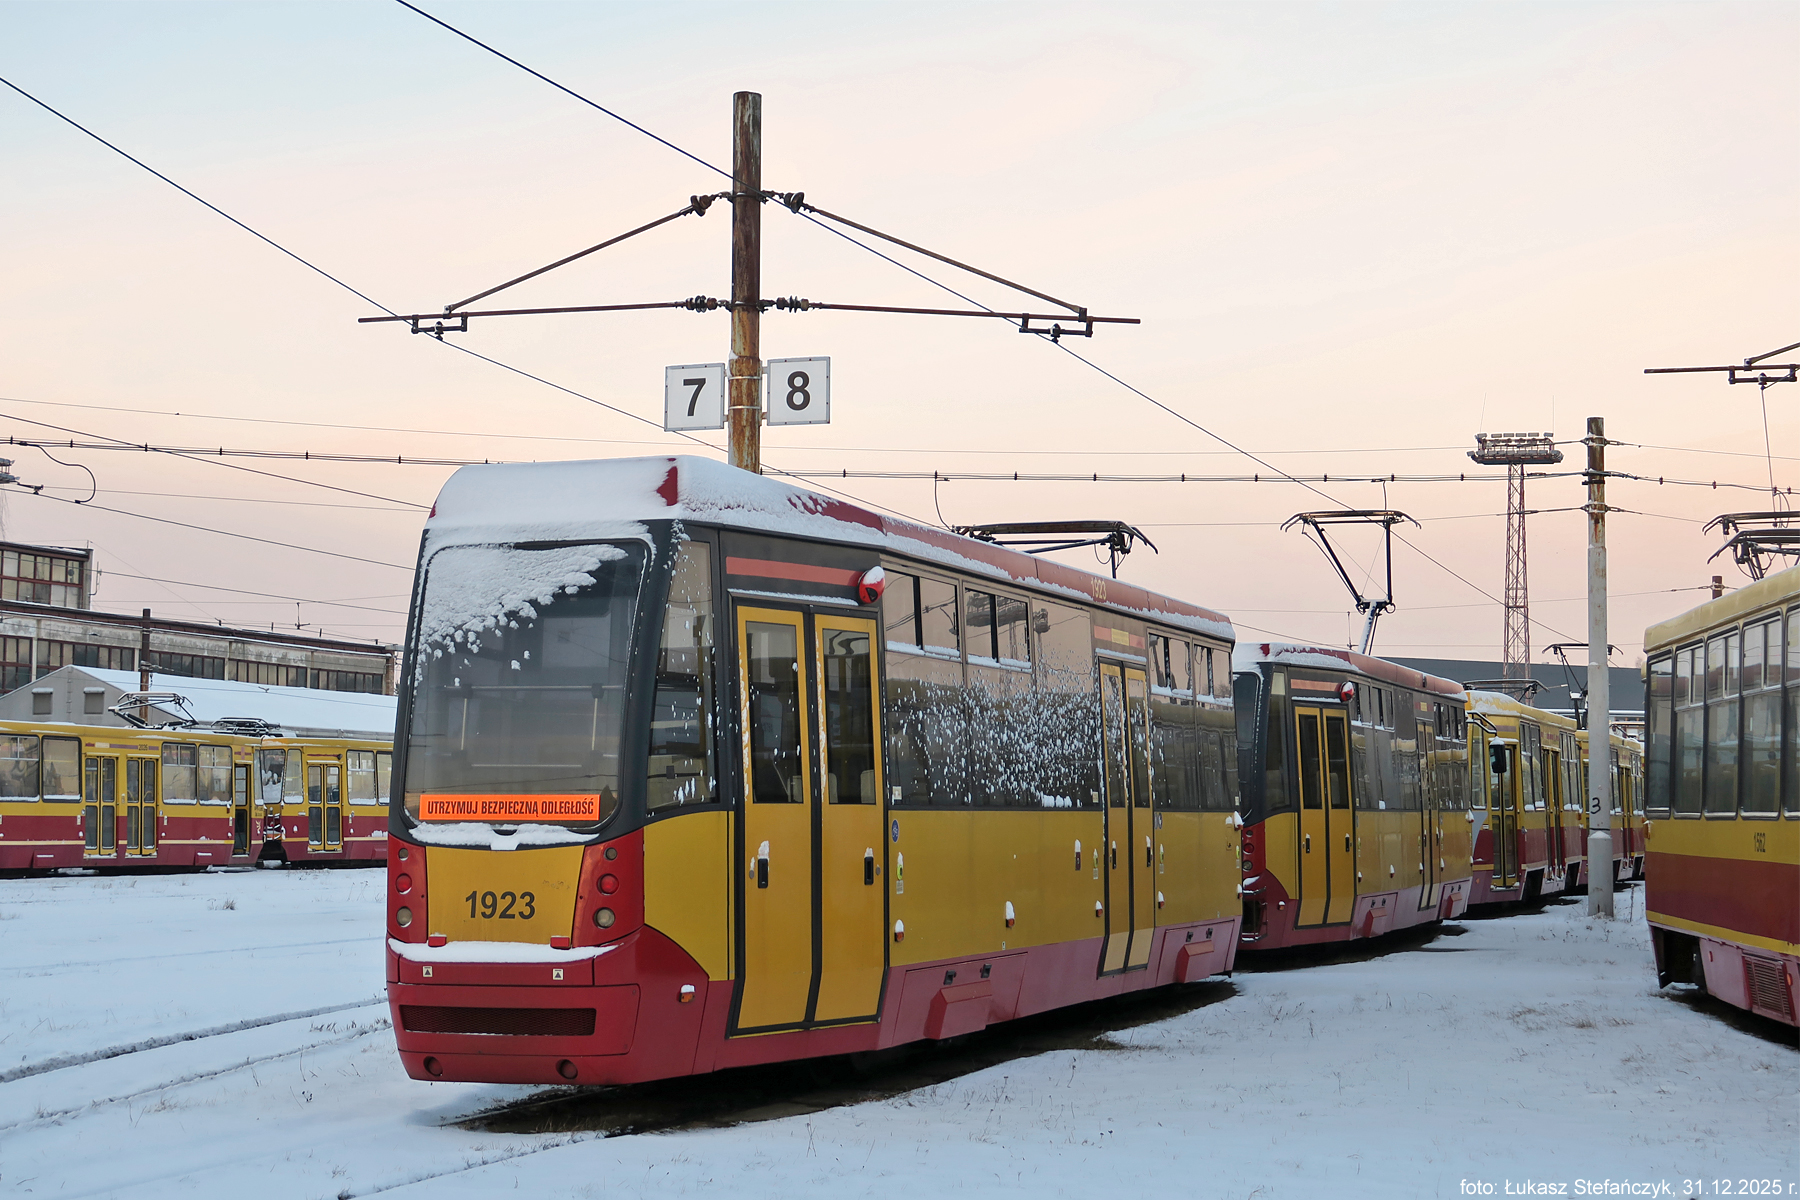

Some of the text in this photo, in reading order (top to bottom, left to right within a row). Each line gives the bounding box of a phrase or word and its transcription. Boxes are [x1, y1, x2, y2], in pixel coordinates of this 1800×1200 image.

[683, 378, 706, 417] 7
[786, 371, 811, 411] 8
[1090, 577, 1107, 600] 1923
[427, 797, 595, 818] UTRZYMUJ BEZPIECZNĄ ODLEGŁOŚĆ
[1590, 797, 1601, 814] 3
[465, 891, 536, 919] 1923
